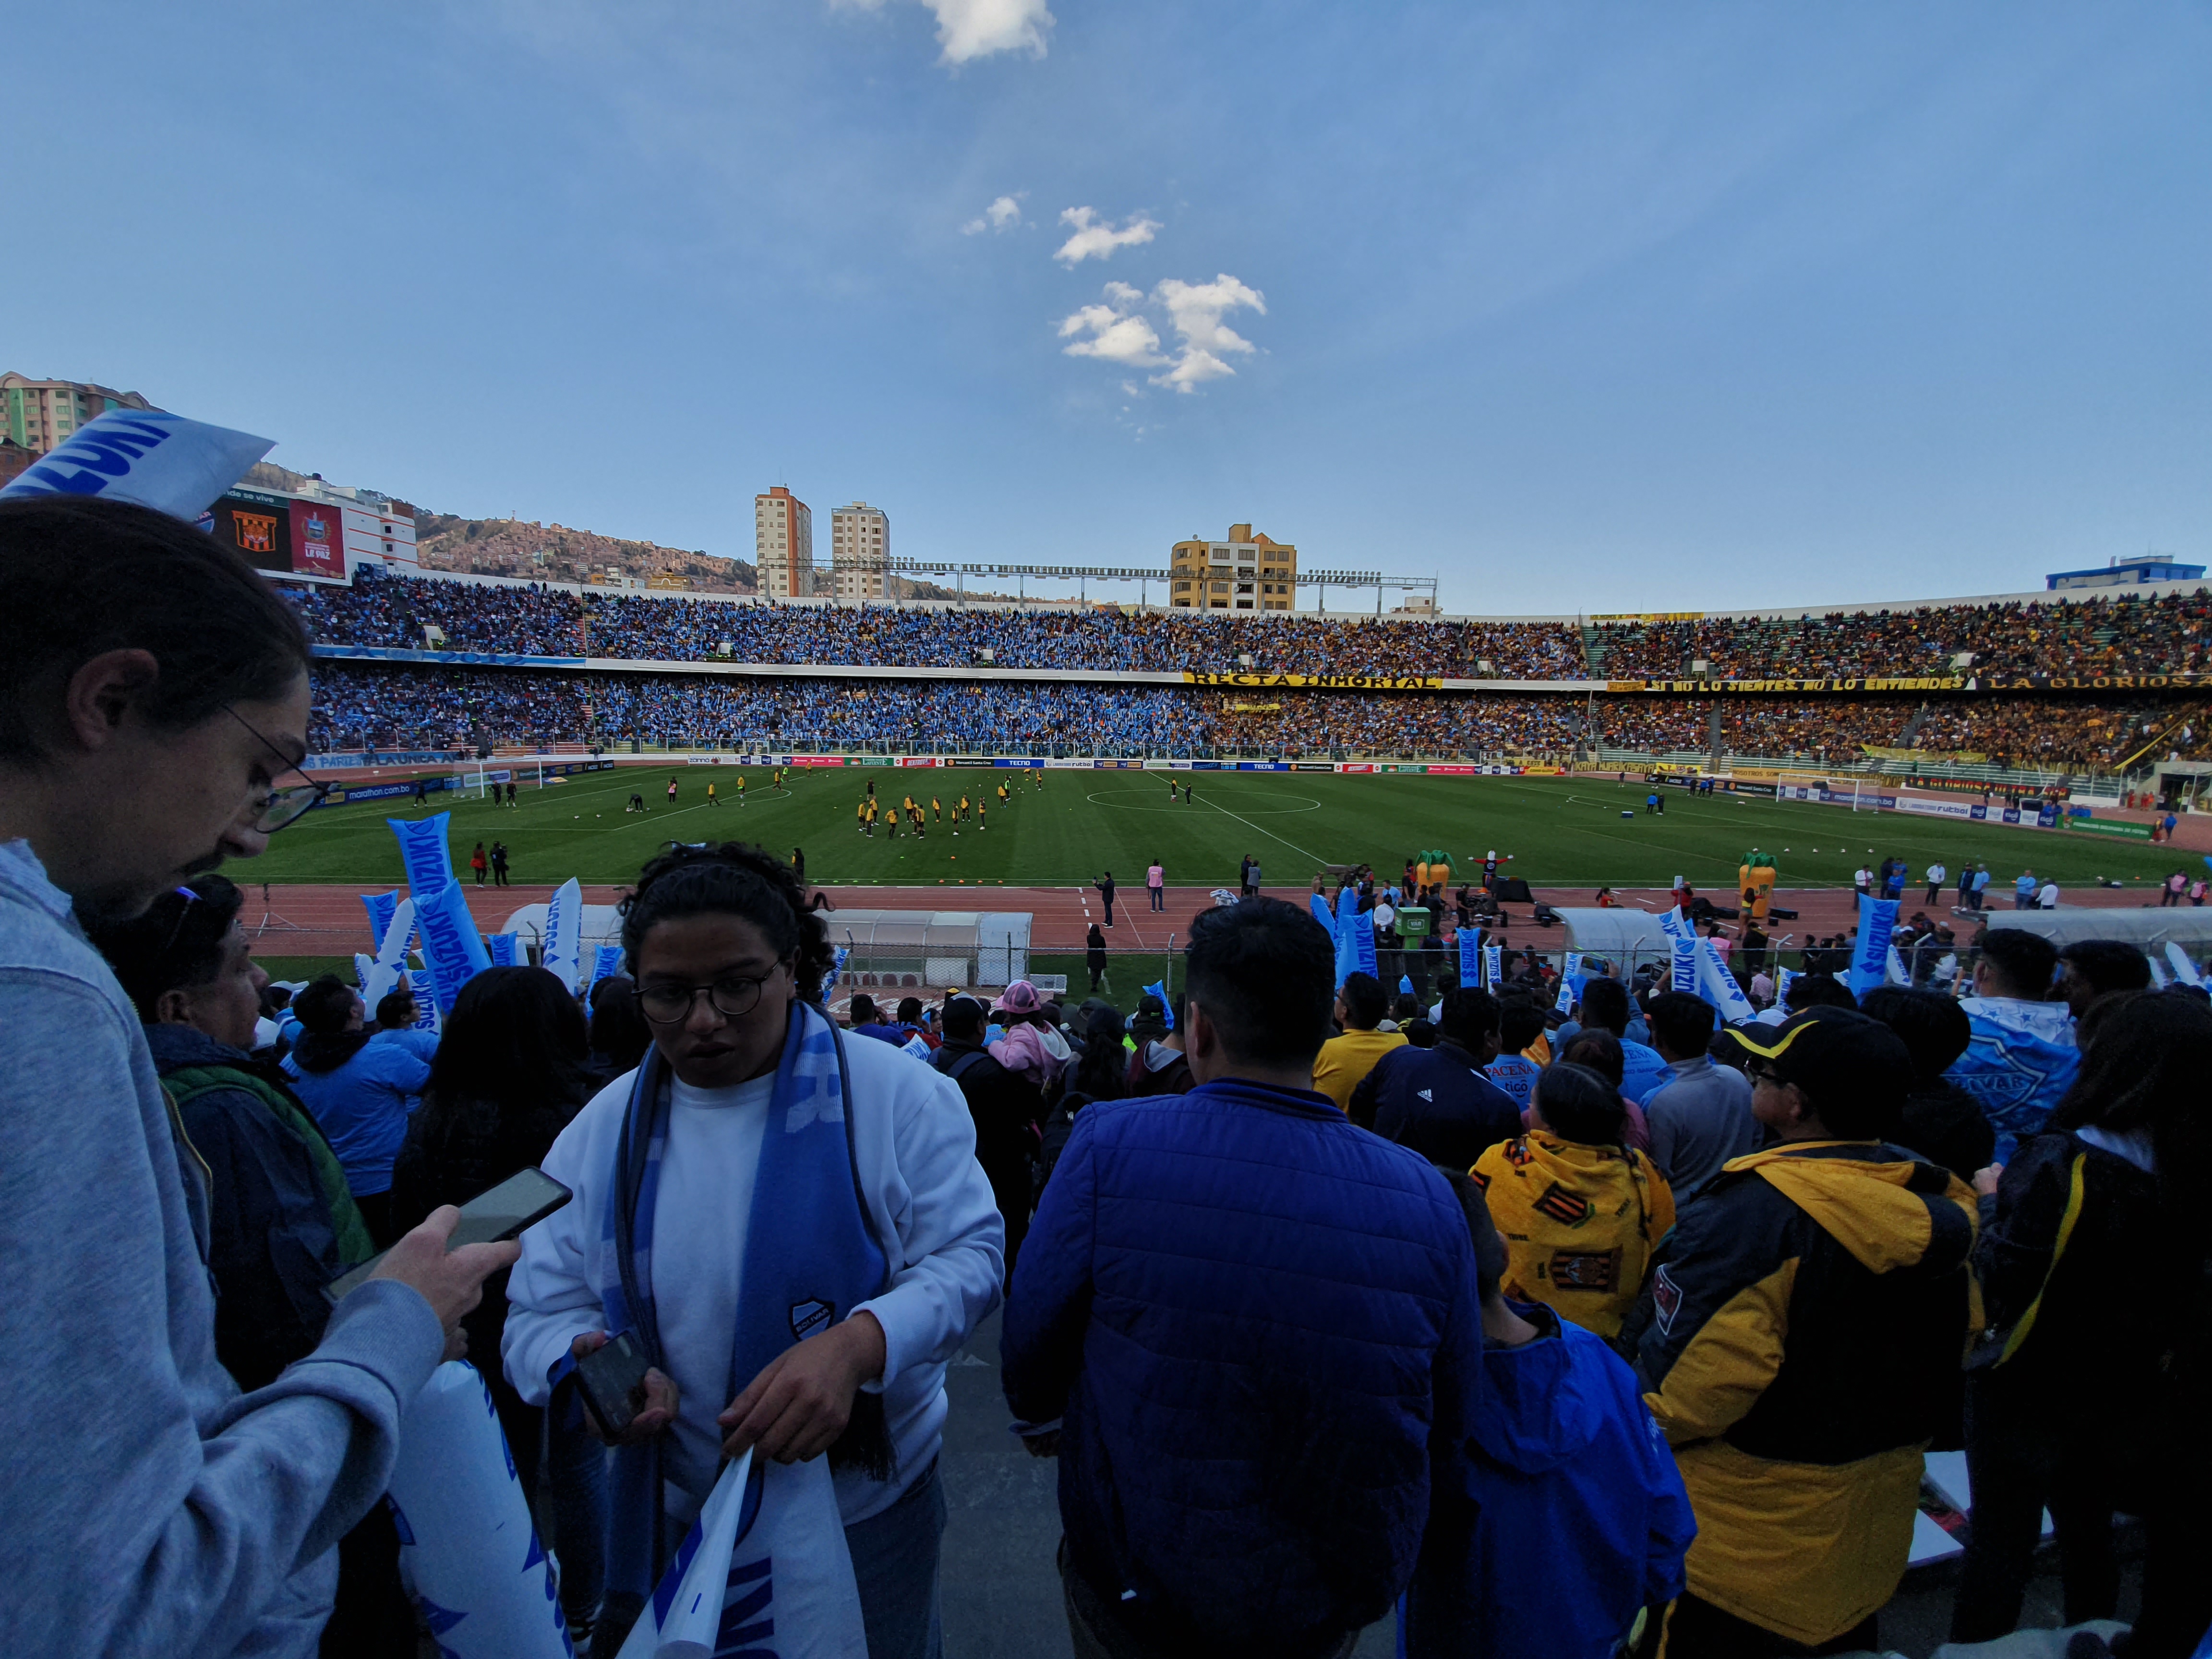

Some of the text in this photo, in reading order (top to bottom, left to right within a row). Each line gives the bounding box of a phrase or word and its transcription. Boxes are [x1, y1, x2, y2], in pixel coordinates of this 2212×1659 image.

[1193, 673, 1436, 688] RECTA INMORTAL
[1698, 681, 1721, 691] LO
[1803, 680, 1826, 691] NO
[1832, 680, 1856, 691] LO
[1864, 677, 1965, 690] ENTIENDES
[1985, 678, 2036, 689] LA
[349, 785, 410, 800] marathon.com.bo
[1866, 912, 1893, 960] SUZUKI
[423, 911, 474, 983] SUZUKI
[1466, 938, 1478, 969] SUZUKI
[1489, 953, 1498, 978] SUZUKI
[1483, 1062, 1535, 1077] PACEÑA
[795, 1308, 830, 1333] BOLIVAR
